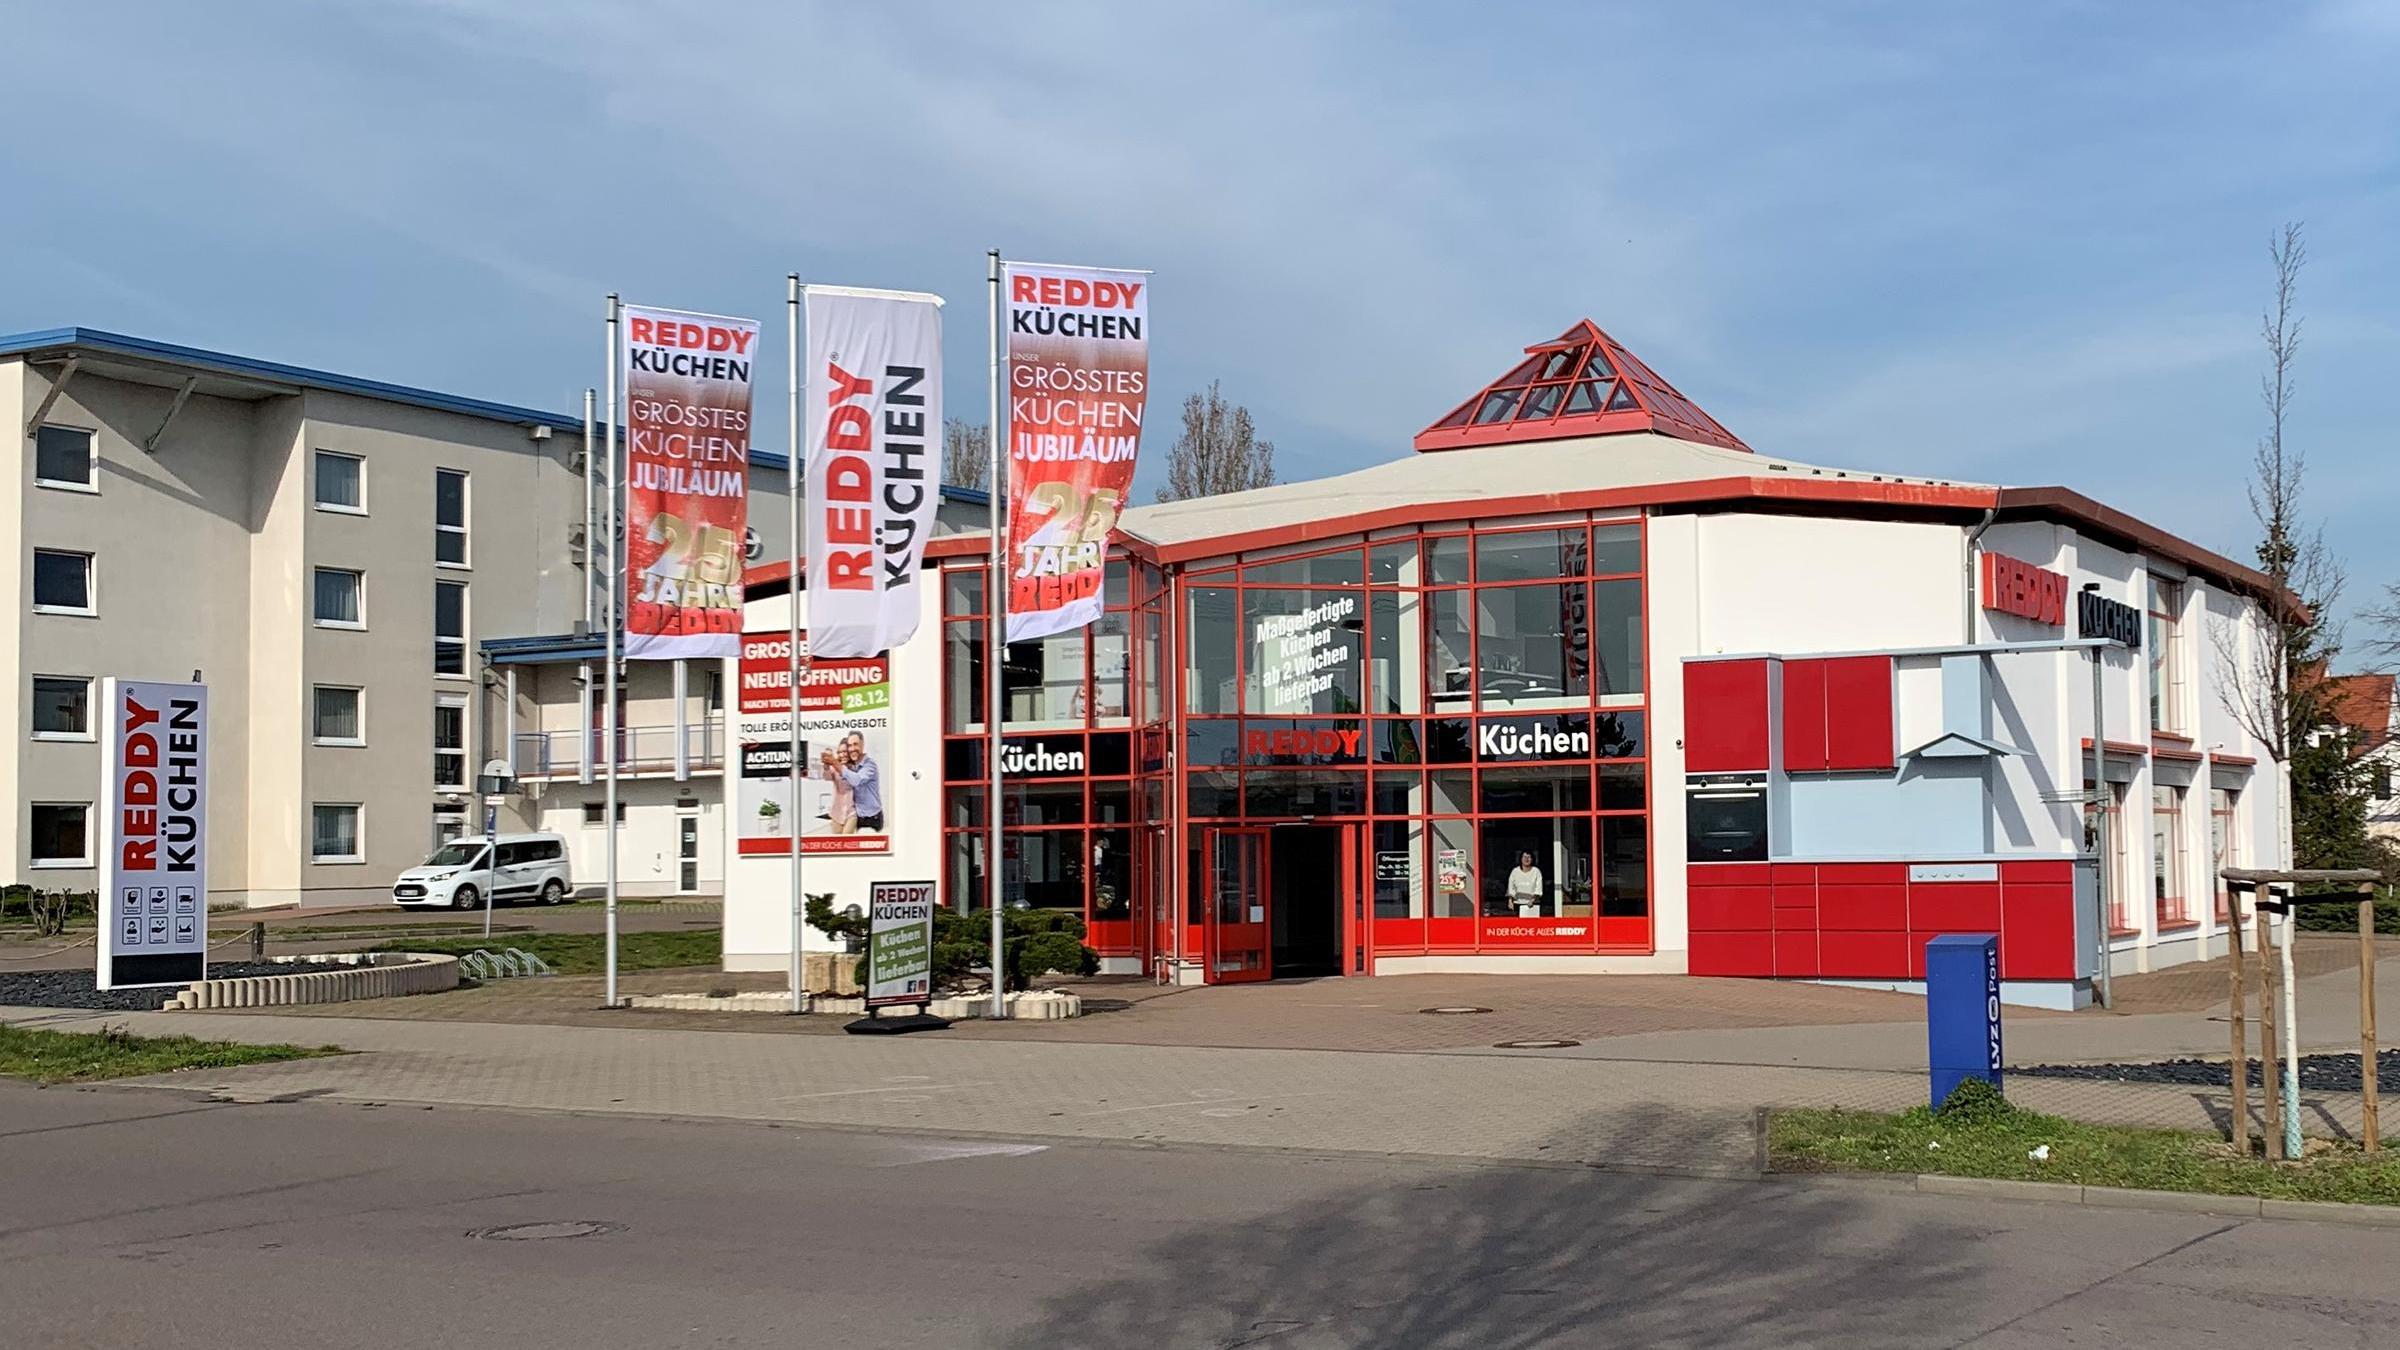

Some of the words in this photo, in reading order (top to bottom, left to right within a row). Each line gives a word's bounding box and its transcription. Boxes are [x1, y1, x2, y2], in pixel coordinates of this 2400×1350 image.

[1013, 275, 1142, 310] REDDY
[631, 317, 753, 354] REDDY
[1013, 306, 1141, 340] KÜCHEN
[631, 347, 749, 382] KÜCHEN
[1013, 353, 1040, 361] UNSER
[1013, 362, 1144, 394] GRÖSSTES
[632, 399, 747, 431] GRÖSSTES
[1013, 391, 1142, 428] KÜCHEN
[632, 425, 746, 463] KÜCHEN
[1014, 427, 1137, 464] JUBILÄUM
[632, 462, 744, 498] JUBILÄUM
[826, 362, 873, 591] REDDY
[875, 365, 925, 591] KÜCHEN
[1024, 481, 1120, 546] 25
[646, 512, 742, 586] 25
[1015, 542, 1100, 578] JAHR
[1010, 569, 1101, 613] REDD
[1988, 553, 2069, 626] REDDY
[1256, 598, 1354, 643] Maßgefertigte
[744, 640, 810, 660] GROSE
[1280, 629, 1331, 659] Küchen
[1263, 665, 1281, 688] ab
[1283, 661, 1293, 680] 2
[1294, 645, 1348, 677] Wochen
[845, 690, 888, 709] 28.12.
[1274, 673, 1334, 706] lieferbar
[741, 722, 767, 733] TOLLE
[1247, 729, 1362, 757] REDDY
[1480, 722, 1589, 755] Küchen
[746, 751, 791, 763] ACHTUN
[123, 695, 160, 871] REDDY
[161, 699, 198, 872] KÜCHEN
[875, 903, 928, 920] KÜCHEN
[876, 888, 929, 903] REDDY
[880, 929, 921, 948] Küchen
[1486, 928, 1495, 936] IN
[1496, 928, 1509, 936] DER
[1510, 926, 1535, 936] KÜCHE
[1555, 928, 1586, 936] REDDY
[877, 960, 928, 981] lieferbar
[890, 951, 896, 960] 2
[1988, 947, 1998, 992] Post
[1990, 1024, 2000, 1070] LVZ
